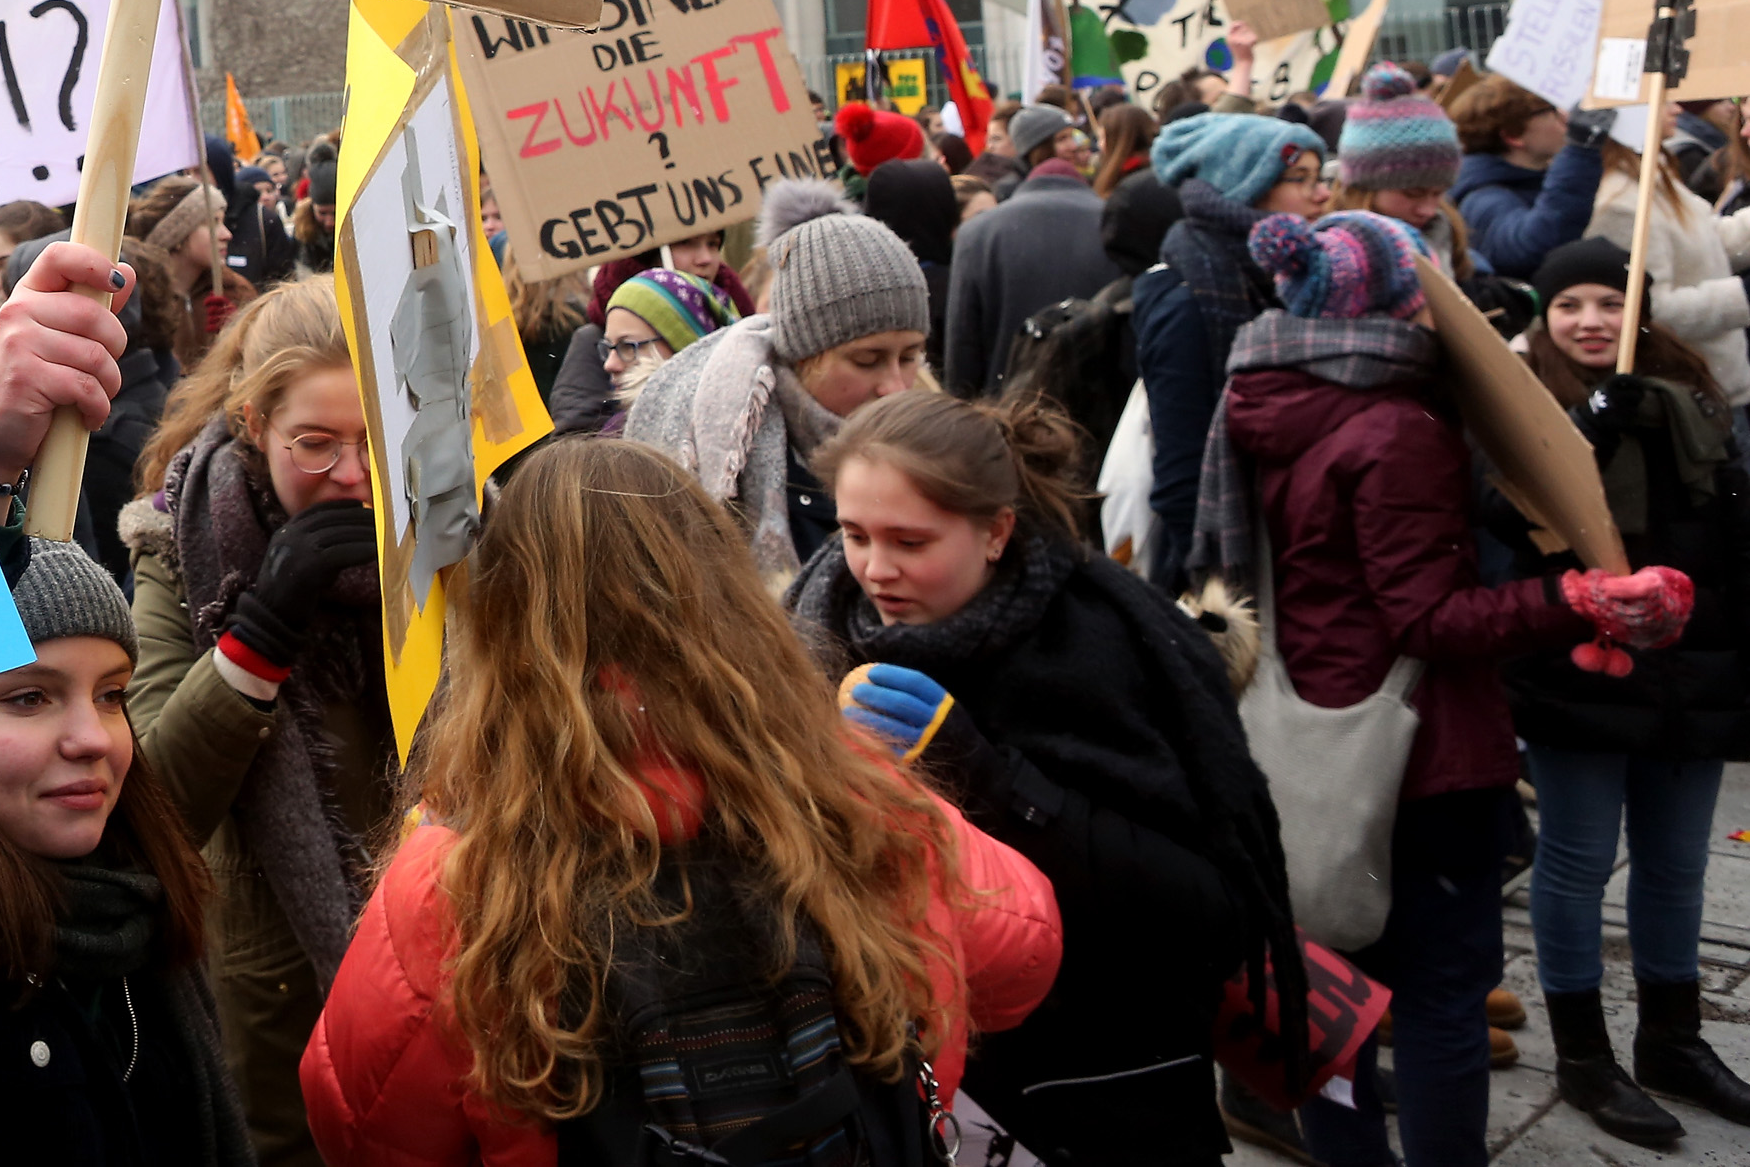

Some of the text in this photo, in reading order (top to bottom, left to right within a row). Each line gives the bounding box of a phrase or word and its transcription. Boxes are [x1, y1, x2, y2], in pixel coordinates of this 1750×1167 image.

[592, 31, 664, 72] DIE
[506, 27, 792, 159] ZUKUNFT
[647, 130, 676, 170] ?
[539, 182, 659, 260] GEBT
[666, 169, 743, 226] UNS
